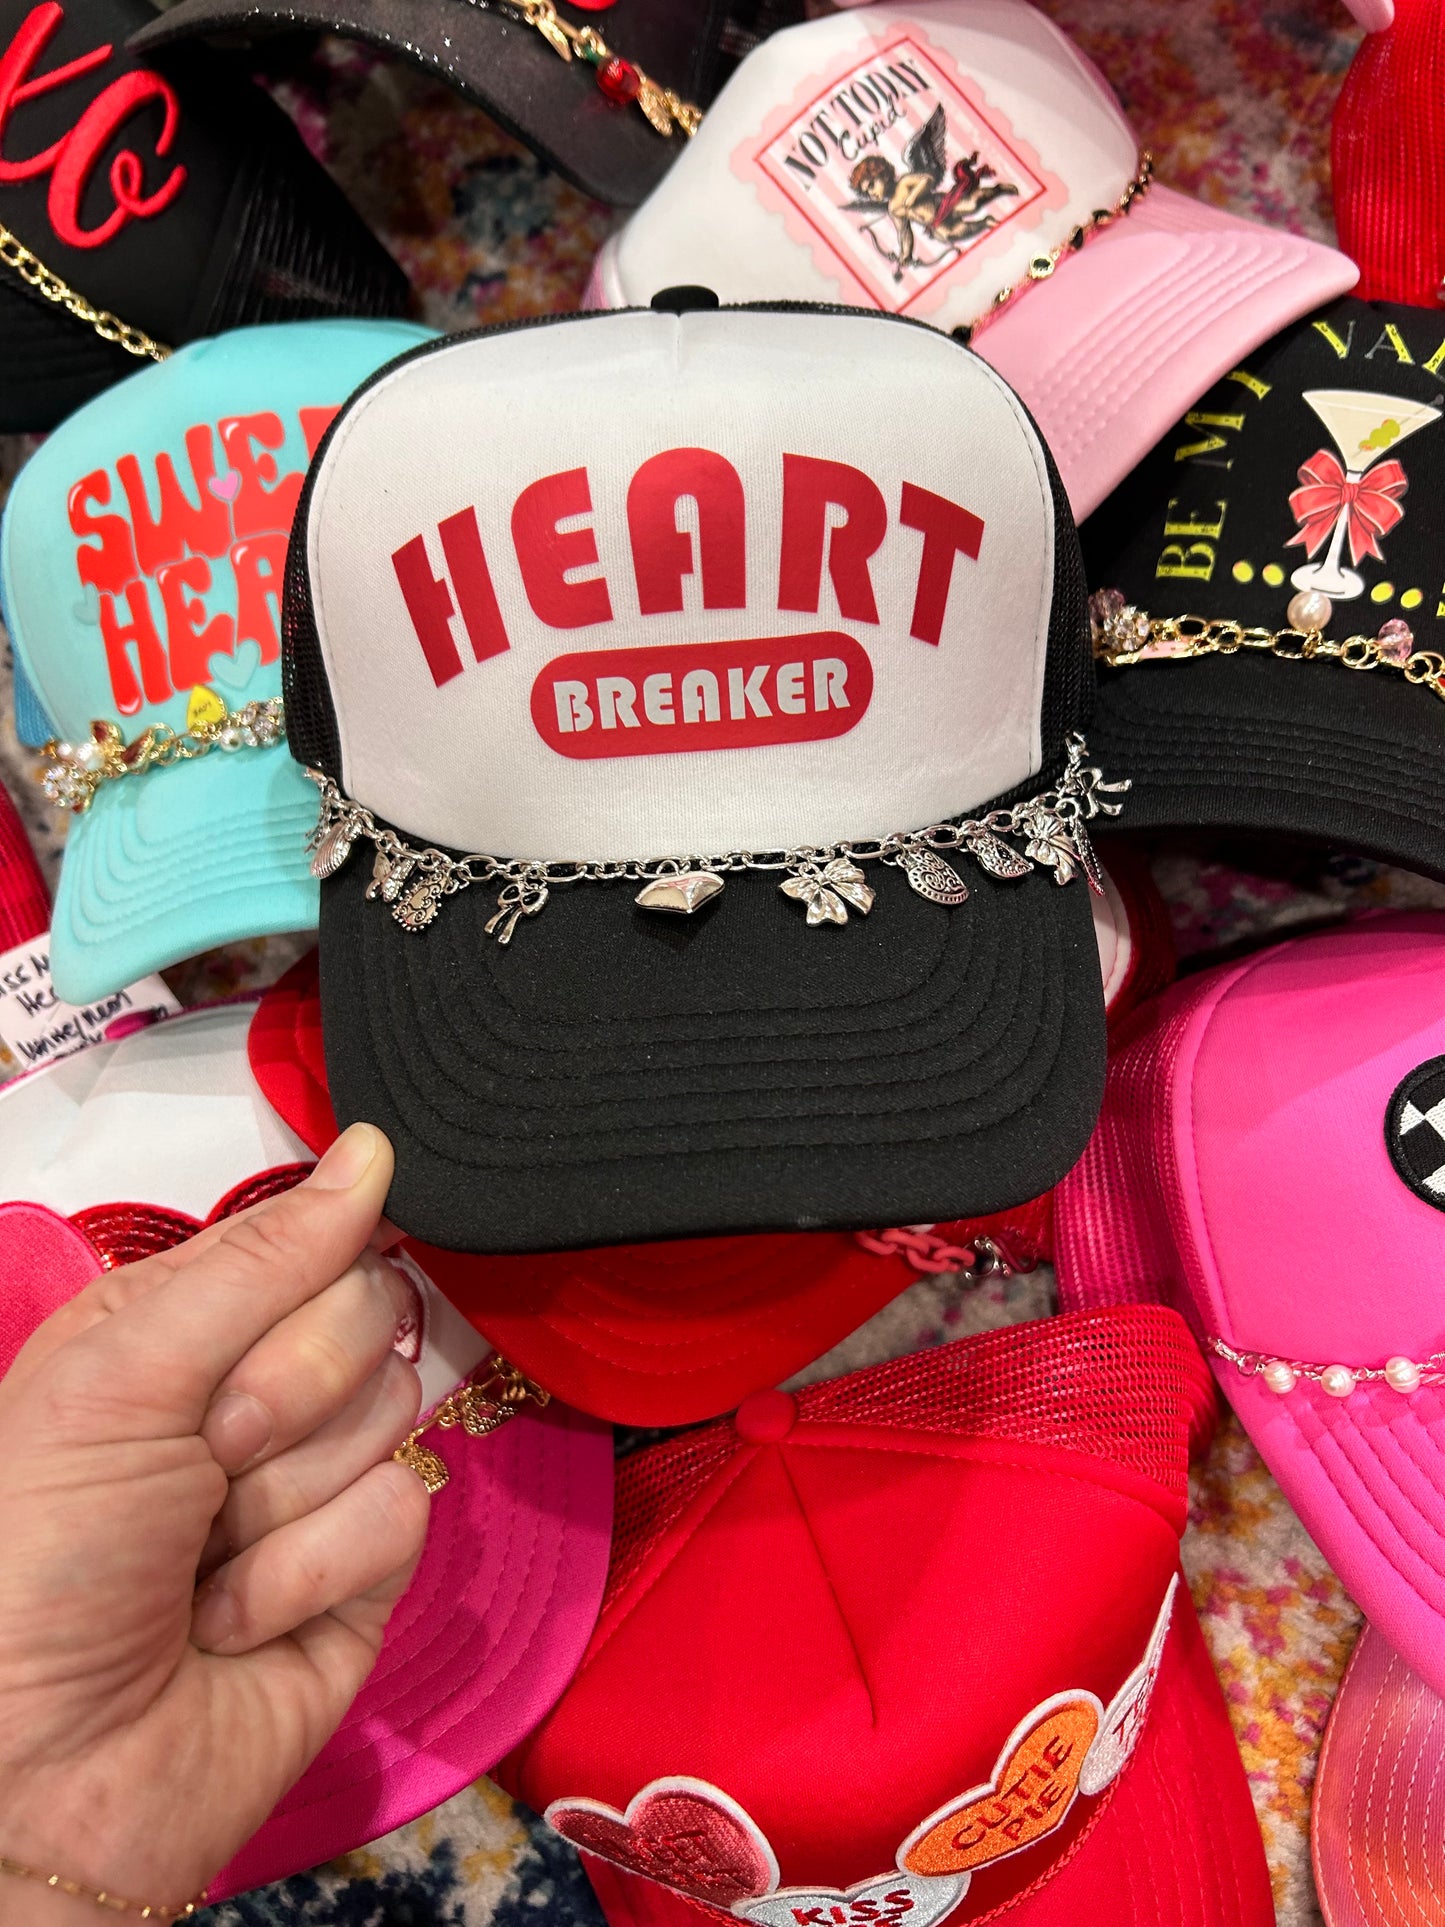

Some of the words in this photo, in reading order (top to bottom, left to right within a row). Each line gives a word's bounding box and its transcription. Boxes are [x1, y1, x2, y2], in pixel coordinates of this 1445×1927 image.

[784, 110, 839, 191] NOT
[831, 59, 930, 126] TODAY
[839, 94, 907, 161] Cupid
[391, 447, 985, 688] HEART
[1156, 498, 1229, 582] BE
[552, 657, 852, 733] BREAKER
[951, 1735, 1074, 1851] CUTIE
[1002, 1780, 1069, 1841] PIE
[790, 1889, 915, 1926] KISS
